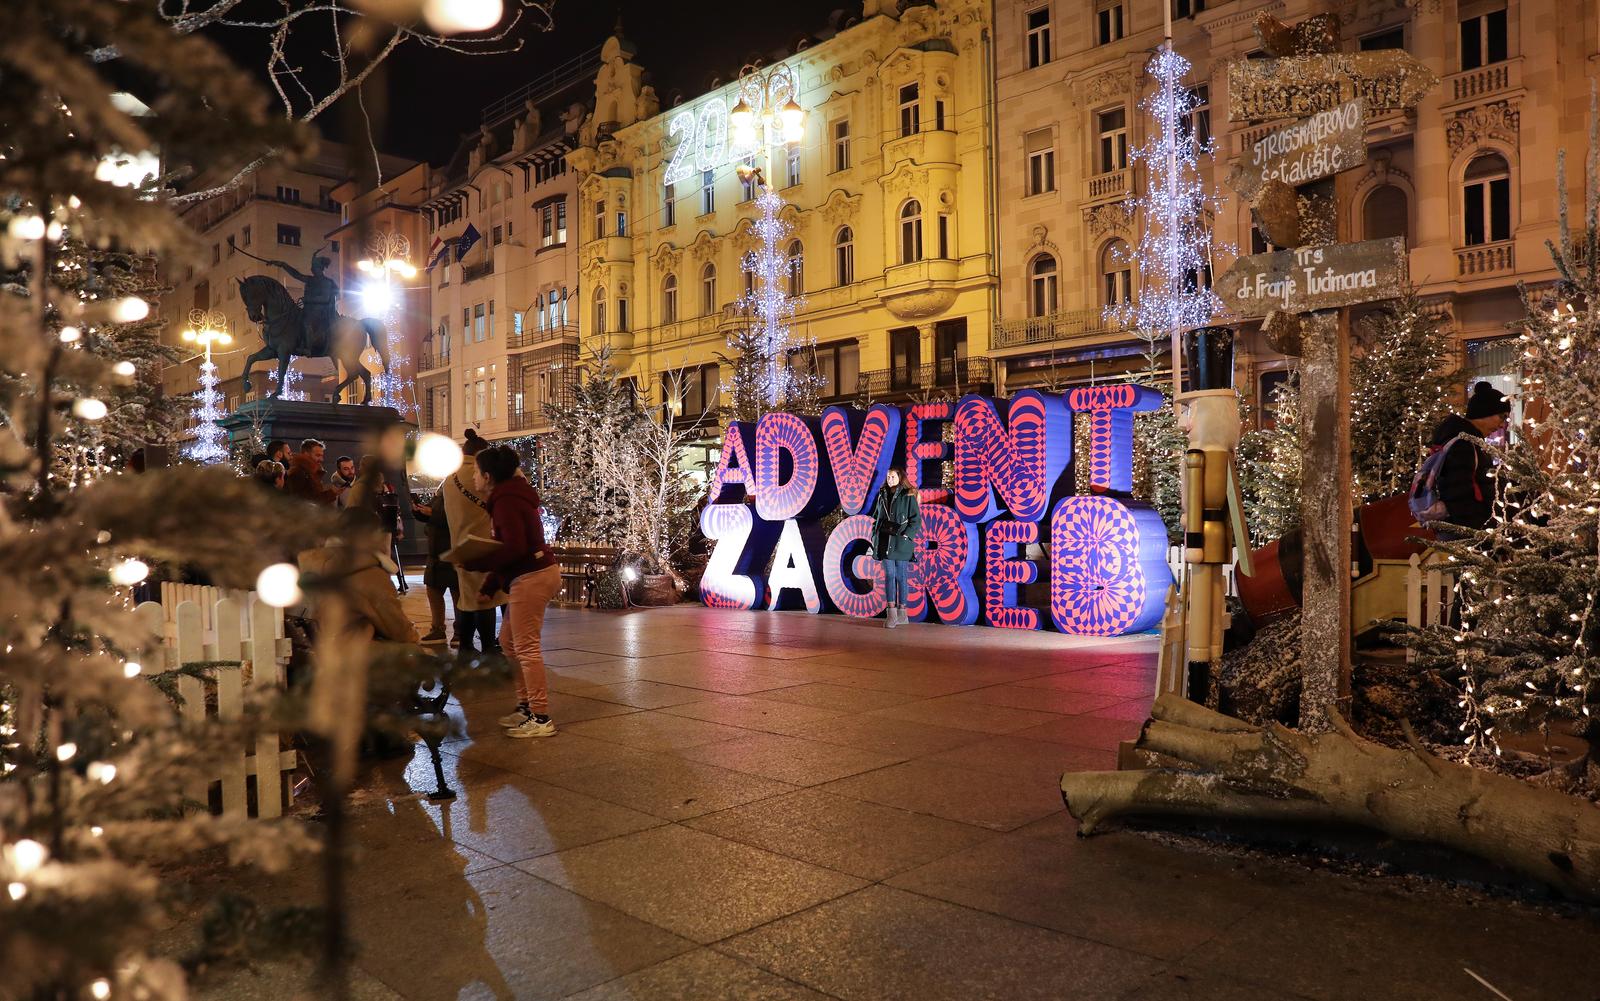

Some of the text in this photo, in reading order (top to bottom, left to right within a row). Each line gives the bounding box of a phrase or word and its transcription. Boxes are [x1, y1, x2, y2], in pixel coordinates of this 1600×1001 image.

[1253, 103, 1358, 165] STROSSMAYEROVO
[1294, 247, 1323, 266] Trg
[706, 384, 1150, 522] ADVENT
[700, 495, 1158, 638] ZAGREB
